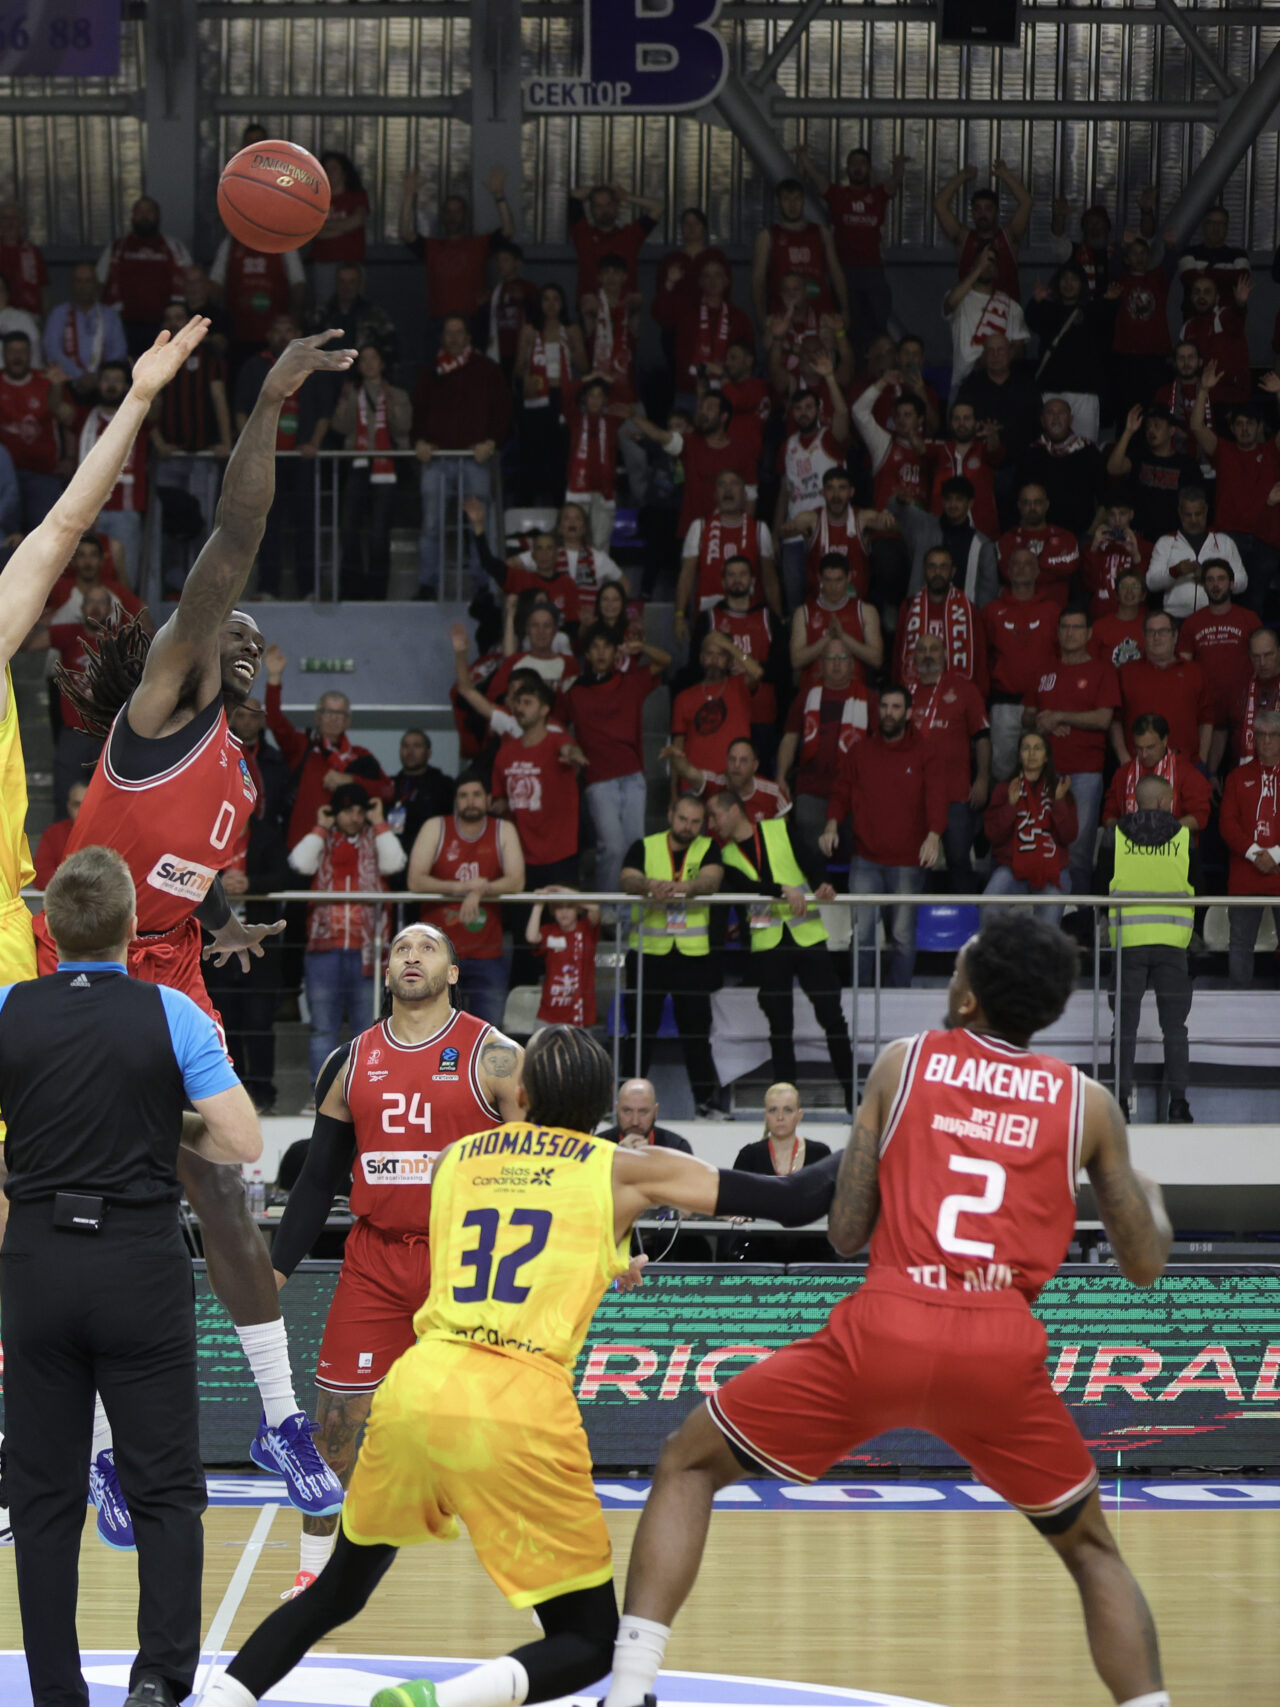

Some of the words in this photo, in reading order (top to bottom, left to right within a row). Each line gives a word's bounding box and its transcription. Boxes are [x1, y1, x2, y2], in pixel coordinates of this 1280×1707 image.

[49, 17, 93, 50] 88
[529, 82, 632, 107] СЕКТОР
[210, 800, 236, 850] 0
[924, 1053, 1064, 1105] BLAKENEY
[381, 1092, 432, 1134] 24
[459, 1130, 597, 1164] THOMASSON
[936, 1154, 1007, 1260] 2
[452, 1208, 553, 1304] 32
